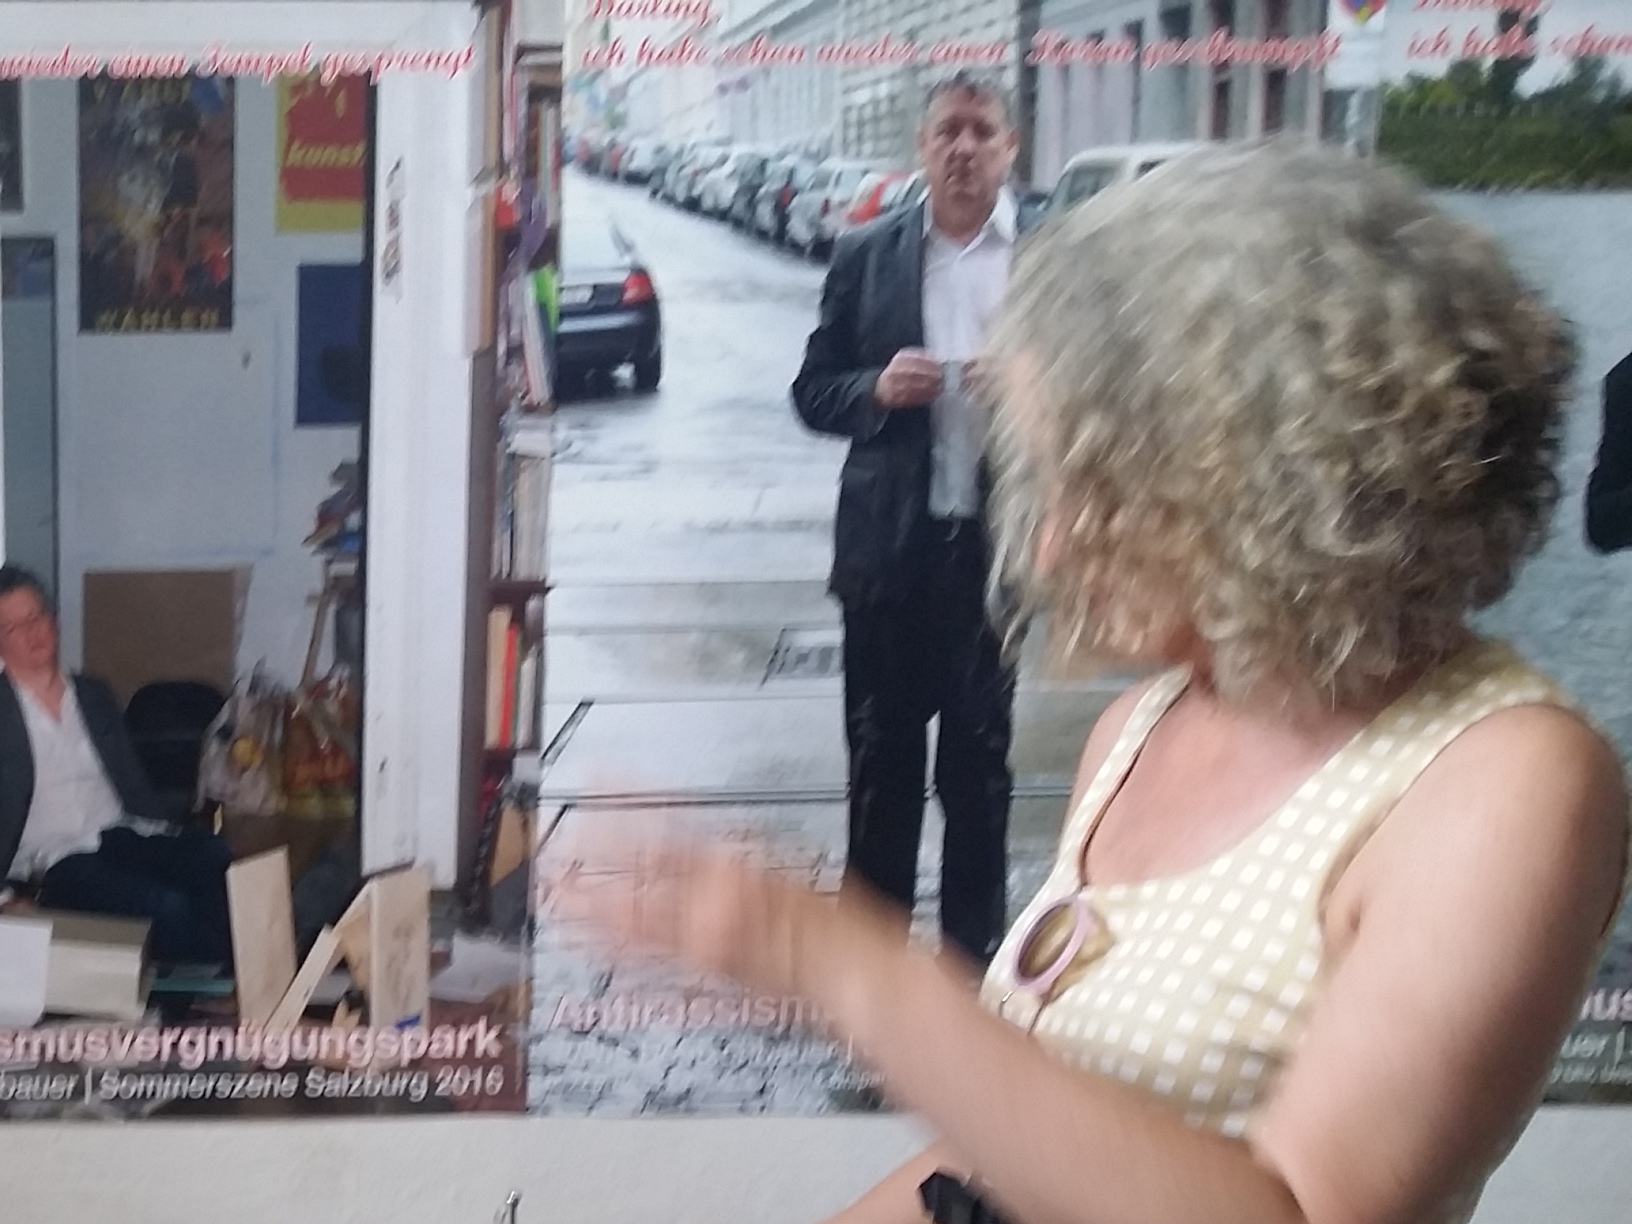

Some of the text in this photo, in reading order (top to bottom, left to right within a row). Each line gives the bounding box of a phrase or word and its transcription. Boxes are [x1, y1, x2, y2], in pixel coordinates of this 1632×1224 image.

[100, 1068, 298, 1101] Sommerszene
[304, 1066, 428, 1102] Salzburg
[434, 1065, 505, 1097] 2016
